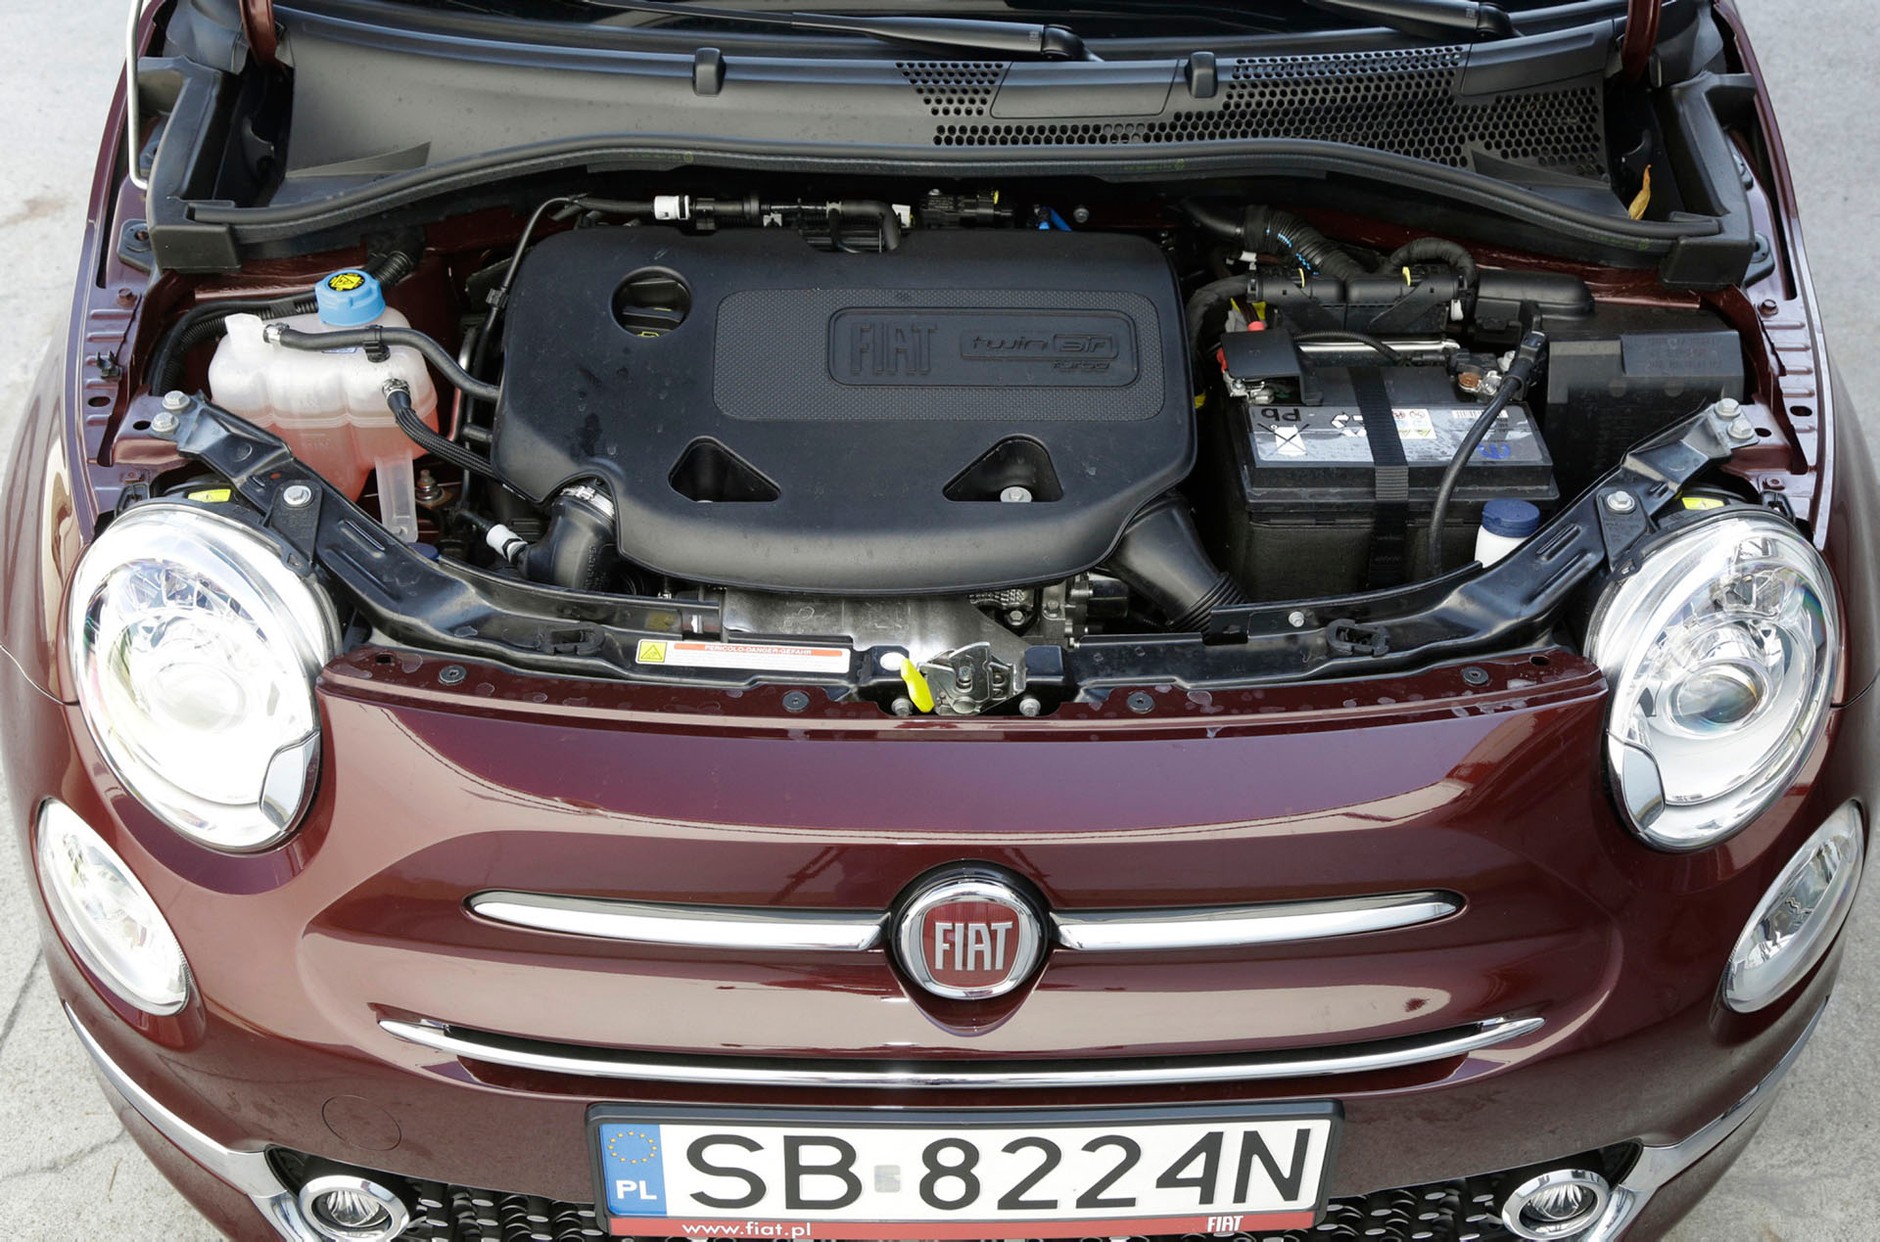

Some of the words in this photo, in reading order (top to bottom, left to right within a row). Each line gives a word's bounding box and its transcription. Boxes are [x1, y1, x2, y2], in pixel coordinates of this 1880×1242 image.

[850, 322, 937, 376] FIAT
[972, 336, 1049, 351] twin
[1261, 408, 1300, 421] Pb
[934, 921, 1013, 971] FIAT
[686, 1134, 863, 1210] SB
[918, 1129, 1312, 1211] 8224N
[616, 1180, 657, 1200] PL
[682, 1221, 812, 1238] www.fiat.pl
[1206, 1215, 1244, 1233] FIAT
